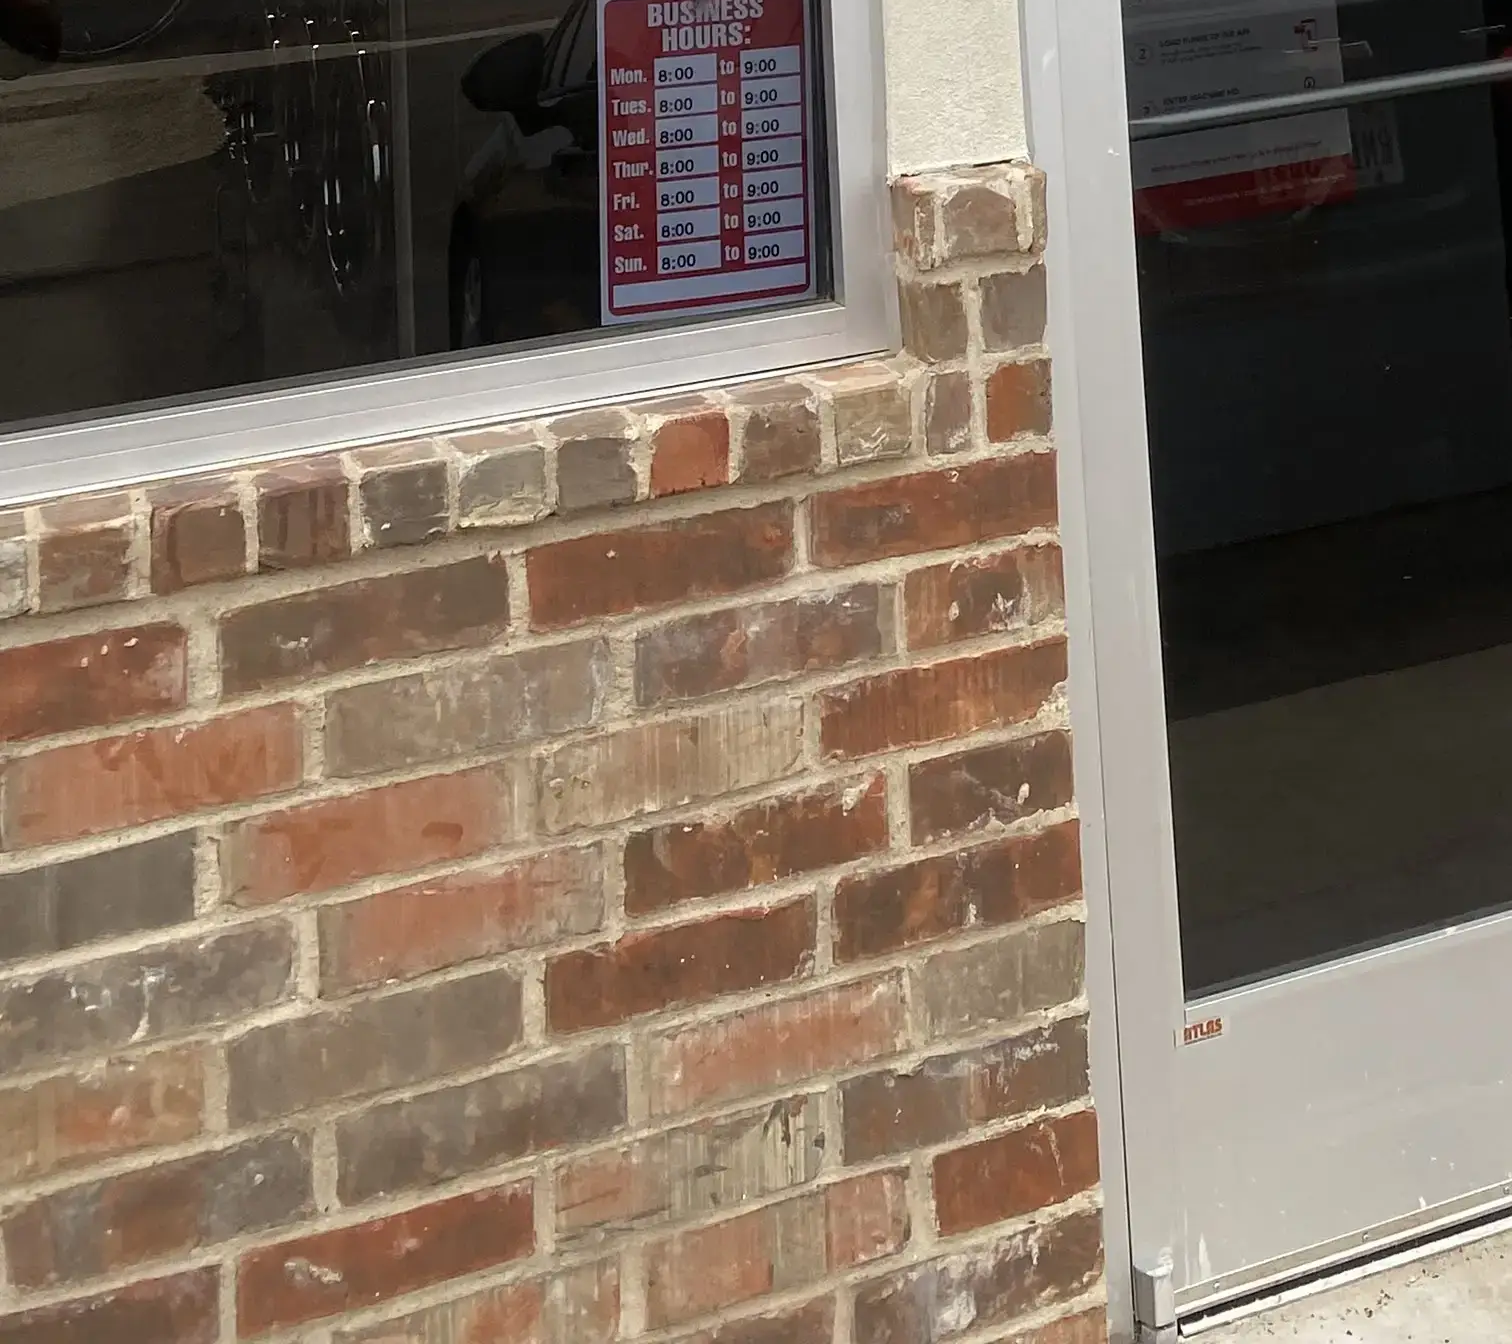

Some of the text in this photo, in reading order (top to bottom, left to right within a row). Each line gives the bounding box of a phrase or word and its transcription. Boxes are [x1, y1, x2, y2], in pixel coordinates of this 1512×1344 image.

[661, 23, 752, 52] HOURS:
[610, 58, 777, 86] Mon. 8:00 to 9:00
[611, 88, 779, 117] Tues. 8:00 to 9:00
[612, 118, 780, 147] Wed. 8:00 to 9:00
[613, 149, 780, 179] Thur. 8:00 to 9:00
[613, 180, 780, 211] Fri. 8:00 to 9:00
[614, 210, 782, 242] Sat. 8:00 to 9:00
[615, 244, 780, 274] Sun. 8:00 to 9:00
[1184, 1017, 1223, 1042] ATLAS
